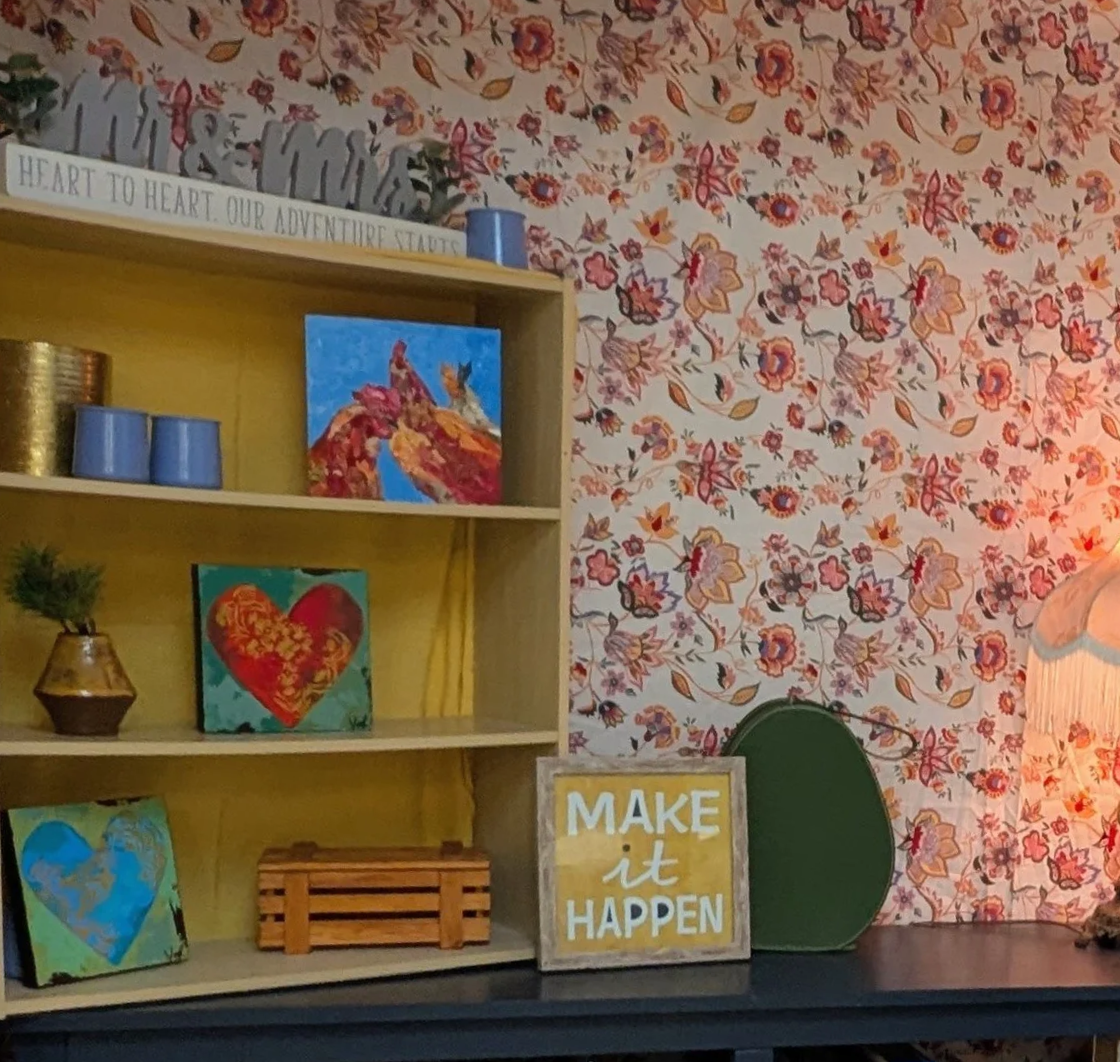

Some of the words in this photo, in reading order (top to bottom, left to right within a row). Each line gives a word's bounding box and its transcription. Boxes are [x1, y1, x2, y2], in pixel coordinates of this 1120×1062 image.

[18, 155, 96, 198] HEART
[107, 171, 136, 207] TO
[226, 196, 265, 231] OUR
[274, 206, 387, 247] ADVENTURE
[566, 788, 721, 837] MAKE
[602, 840, 679, 889] it
[566, 893, 724, 941] HAPPEN
